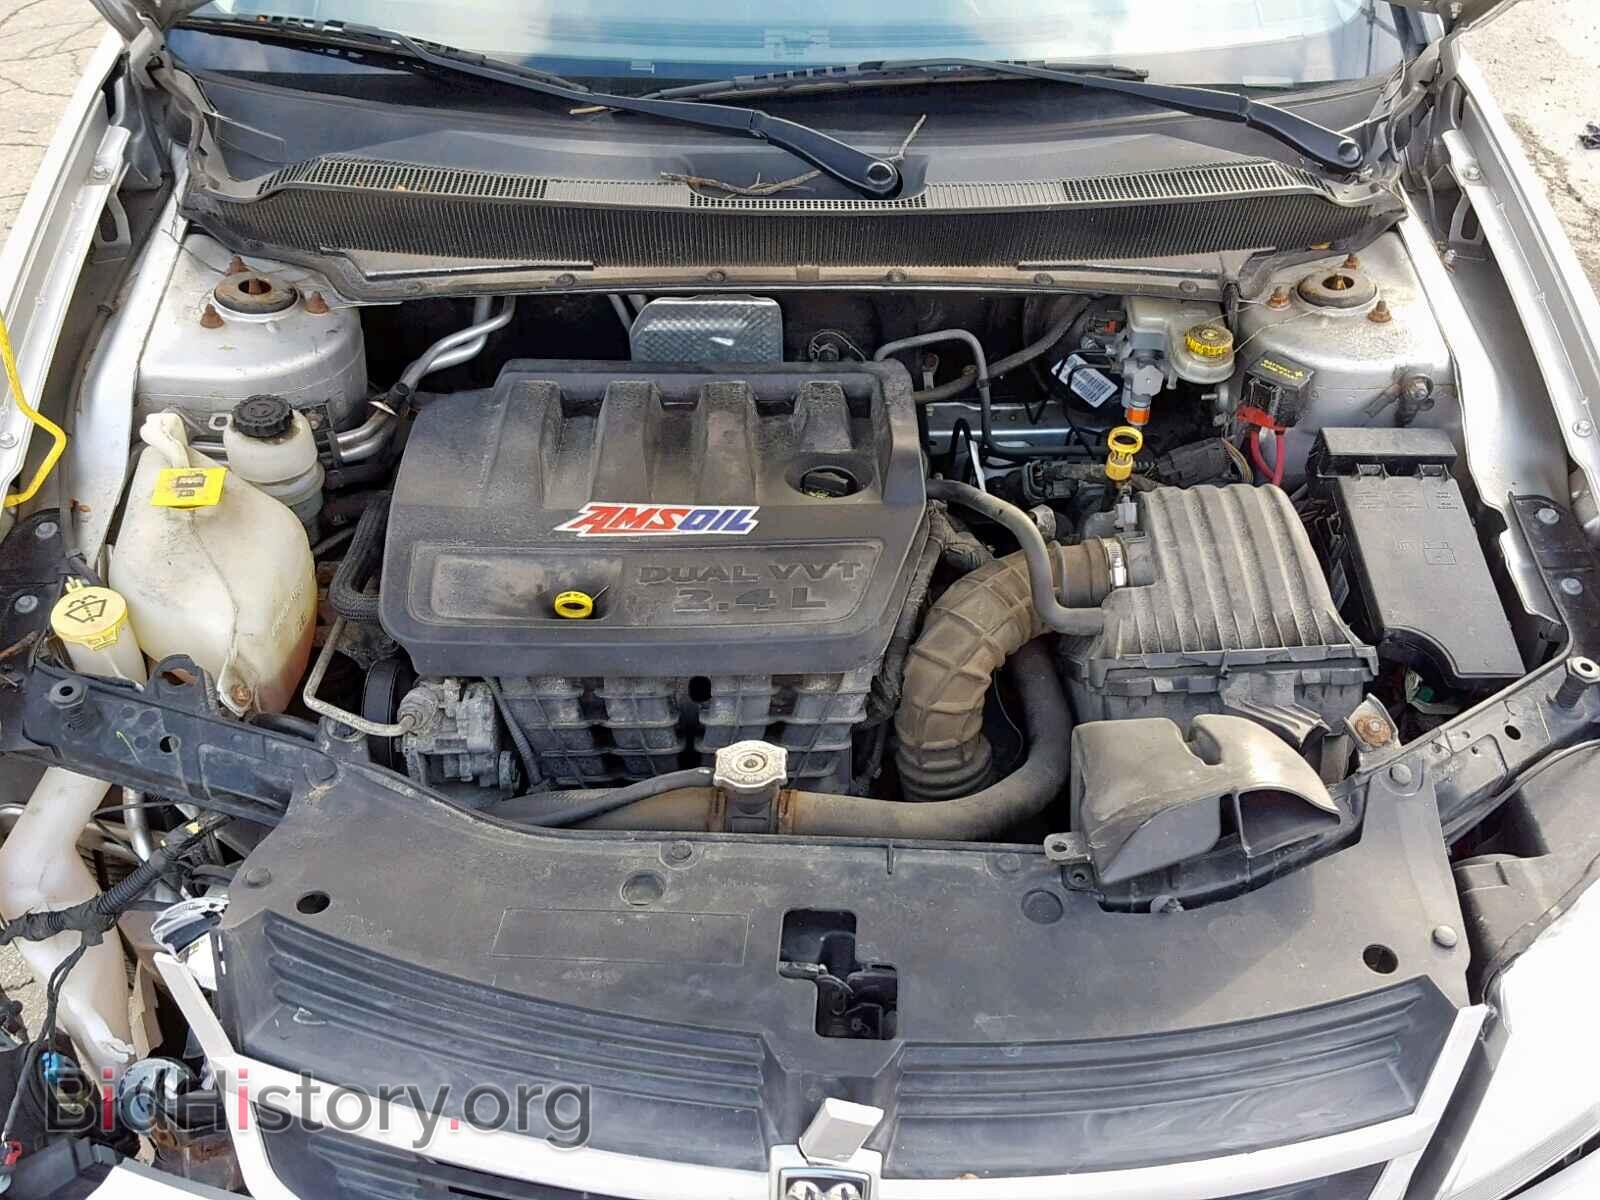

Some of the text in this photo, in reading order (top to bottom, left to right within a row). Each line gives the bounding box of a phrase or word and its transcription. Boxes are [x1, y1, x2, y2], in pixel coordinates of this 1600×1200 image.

[565, 504, 755, 534] AMSOIL
[639, 561, 864, 584] DUAL VVT
